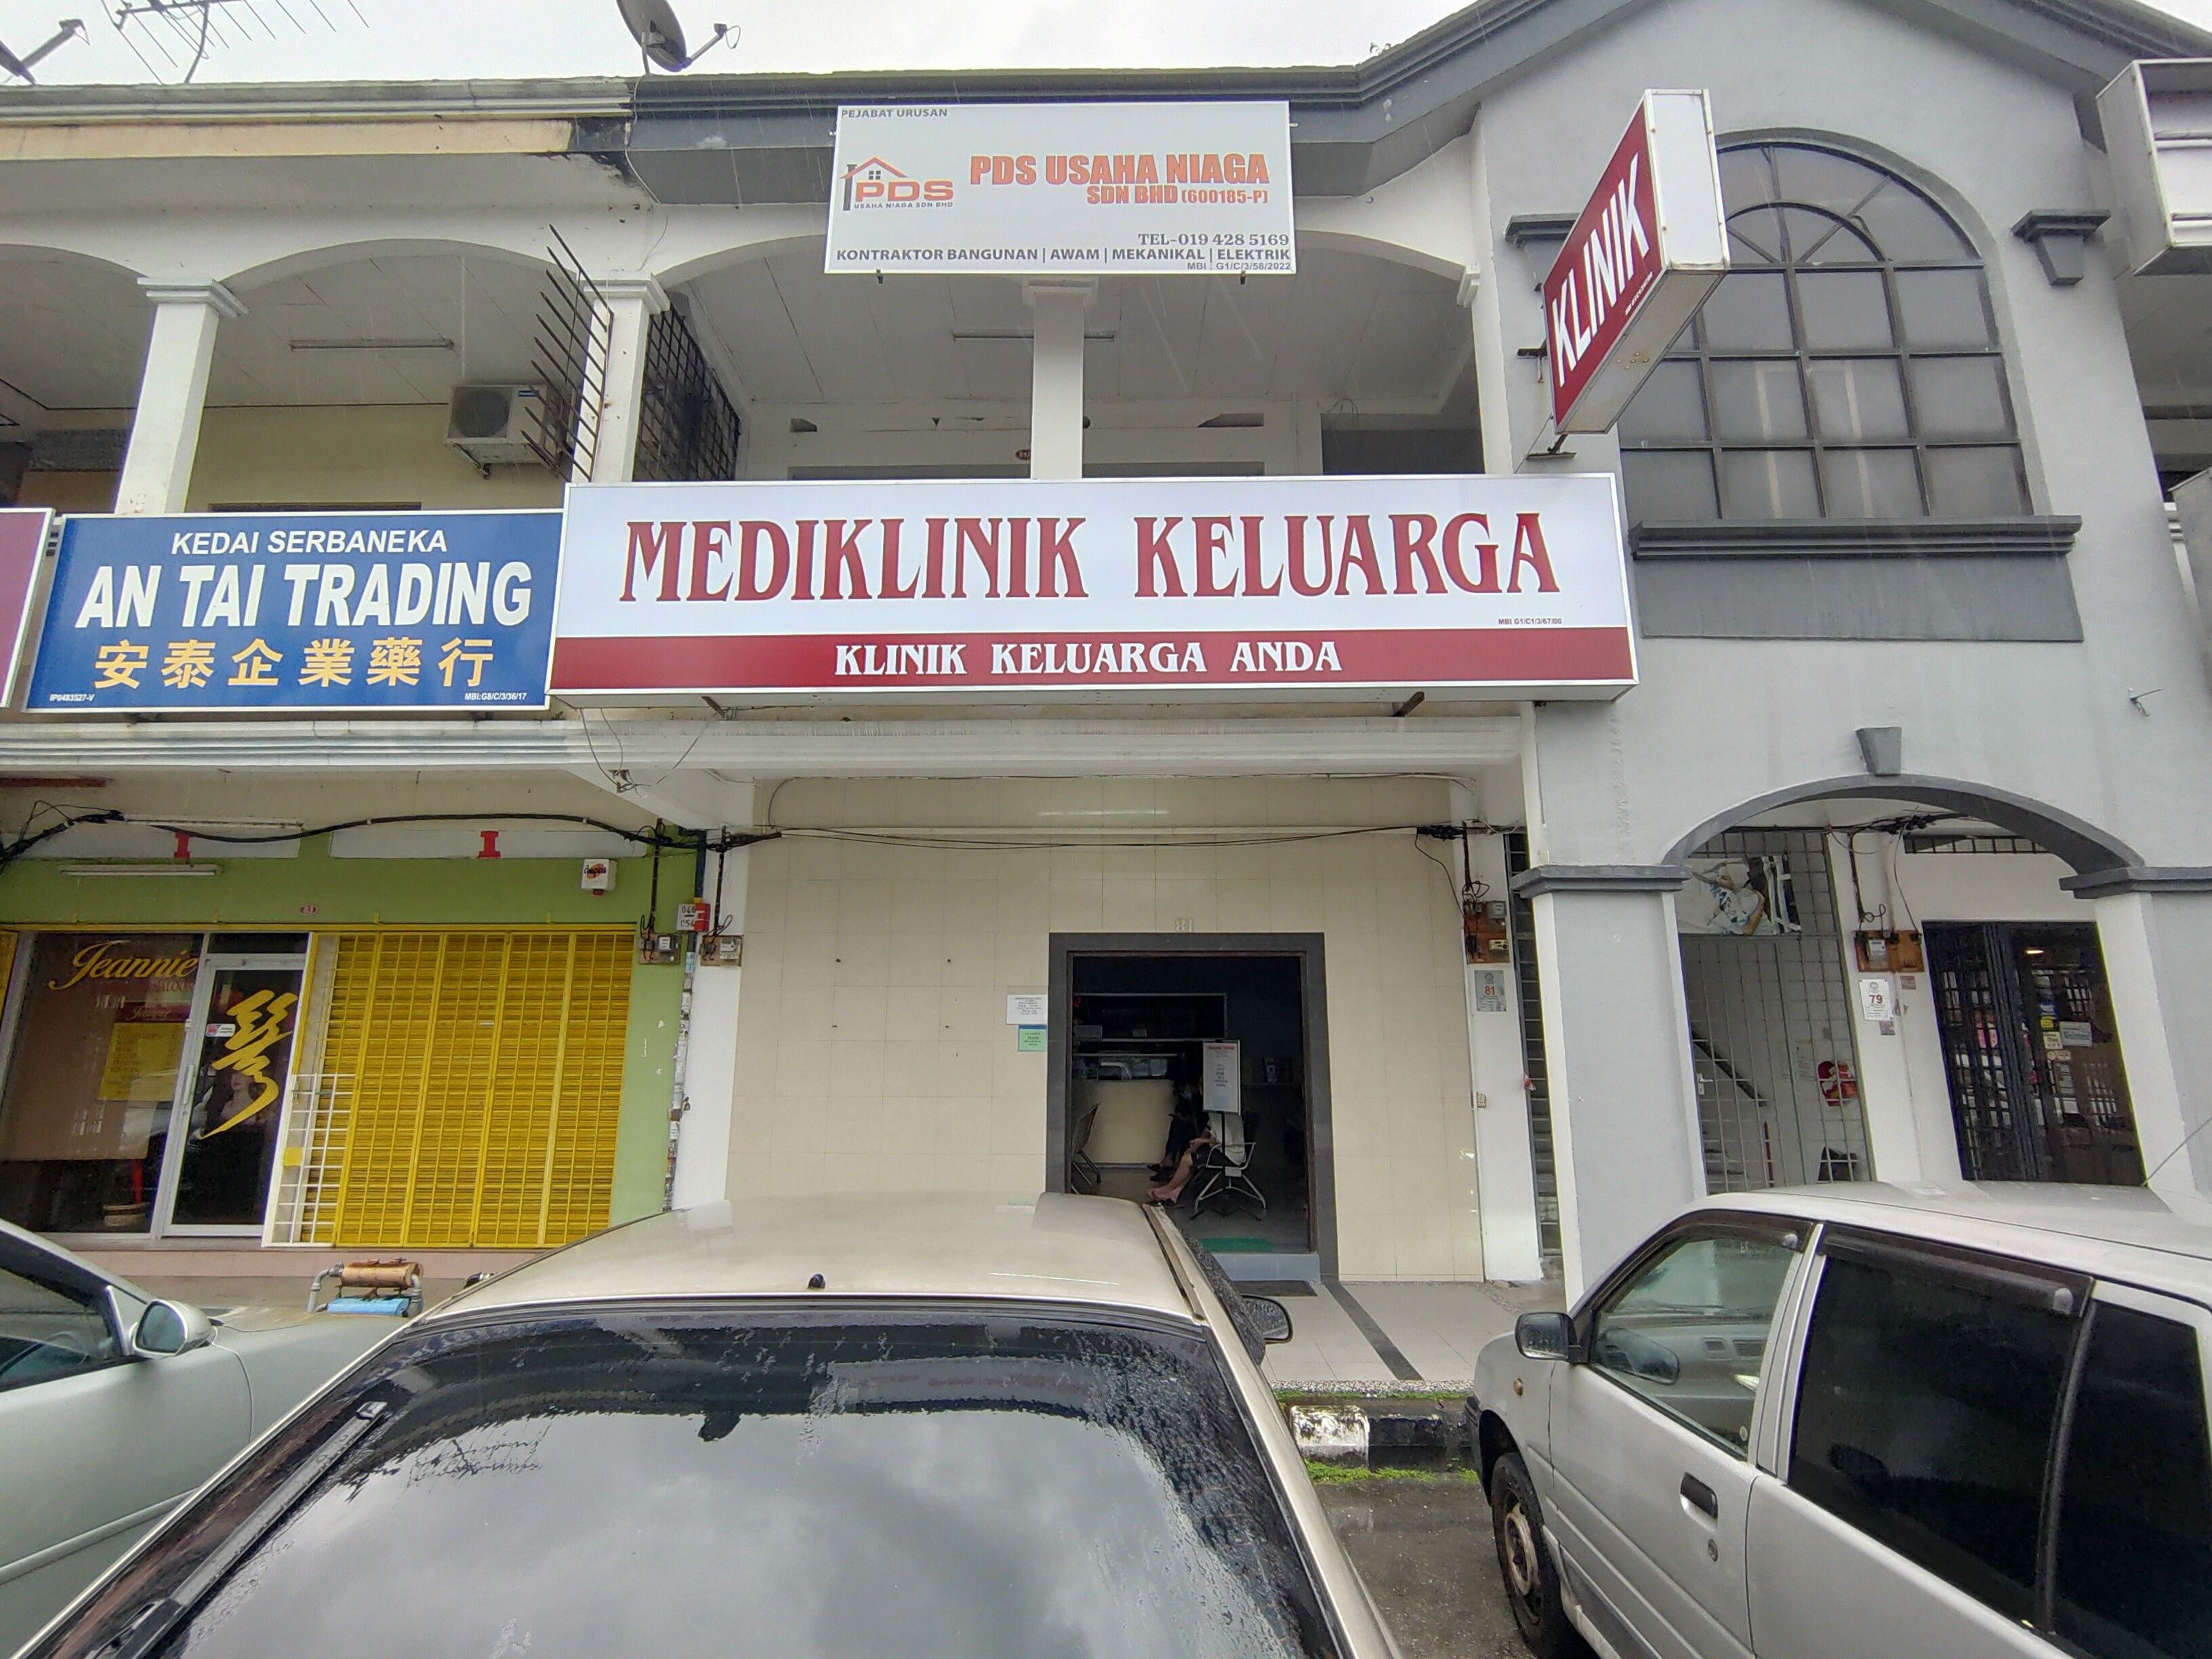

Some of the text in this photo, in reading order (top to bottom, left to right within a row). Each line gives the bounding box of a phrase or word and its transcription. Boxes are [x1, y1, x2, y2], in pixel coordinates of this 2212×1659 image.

[841, 108, 947, 118] PEJABAT URUSAN
[970, 153, 1270, 186] PDS USAHA NIAGA
[855, 178, 954, 203] PDS
[1086, 184, 1268, 205] SDN BHD (600185-P)
[1137, 233, 1290, 246] TEL-019 428 5169
[836, 249, 1290, 260] KONTRAKTOR BANGUNAN AWAM MEKANIKAL ELEKTRIK
[1187, 262, 1206, 270] MBI
[1551, 152, 1650, 387] KLINIK
[171, 529, 447, 554] KEDAI SERBANEKA
[619, 512, 1560, 602] MEDIKLINIK KELUARGA
[75, 561, 532, 628] AN TAI TRADING
[94, 636, 495, 689] 安泰企業藥行
[834, 641, 1343, 675] KLINIK KELUARGA ANDA
[48, 939, 199, 991] Jeannie
[1485, 985, 1495, 996] 81
[1869, 995, 1883, 1004] 79
